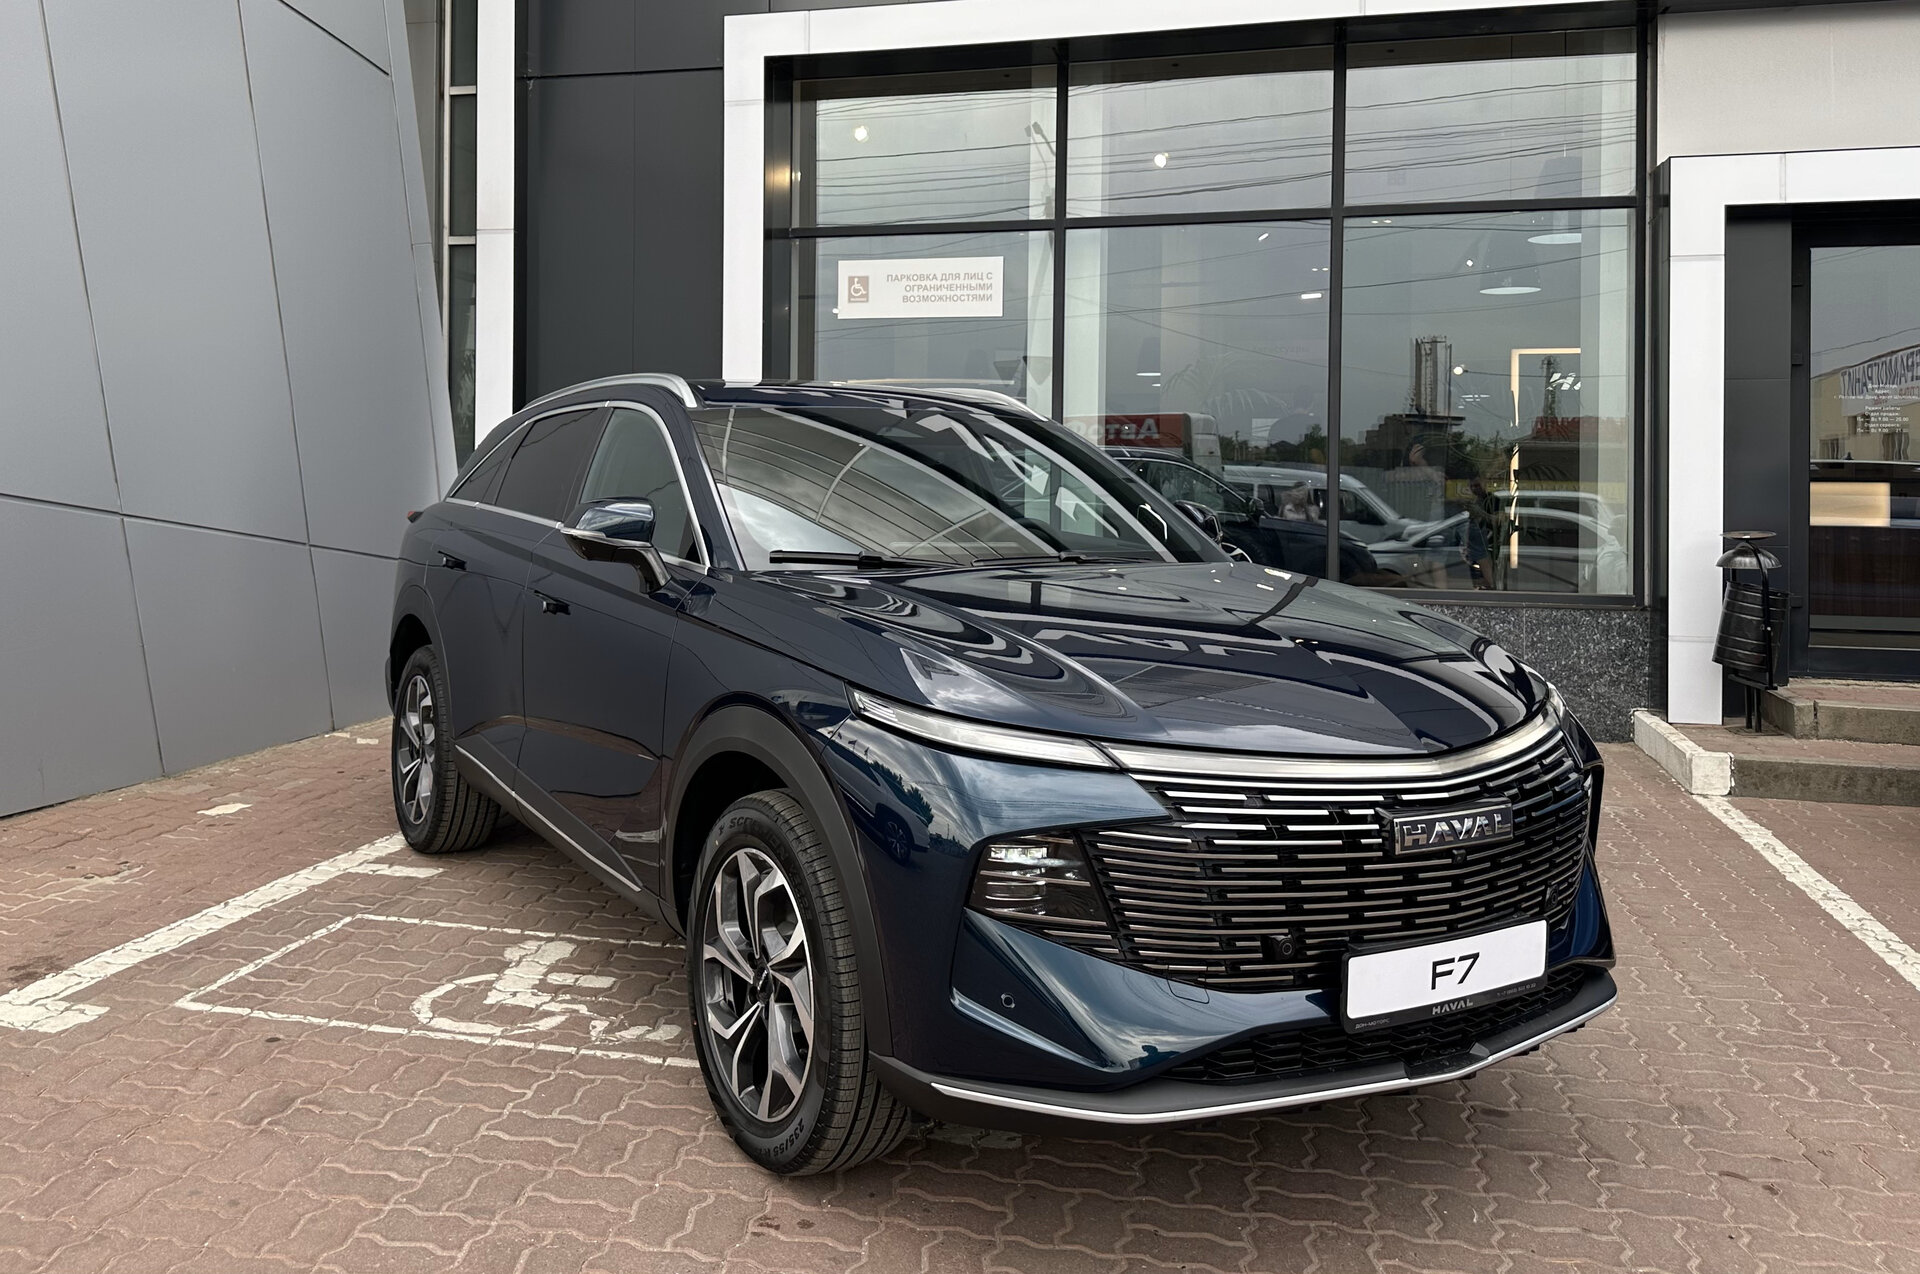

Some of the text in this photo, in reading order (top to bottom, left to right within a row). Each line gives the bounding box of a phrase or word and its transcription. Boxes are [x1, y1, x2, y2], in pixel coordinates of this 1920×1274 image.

[886, 272, 993, 282] ПАРКОВКА ДЛЯ ЛИЦ С
[904, 283, 993, 293] ОГРАНИЧЕННЫМИ
[902, 294, 993, 304] ВОЗМОЖНОСТЯМИ
[1402, 813, 1511, 847] HAVAL
[1431, 951, 1480, 990] F7
[1432, 999, 1474, 1016] HAVAL
